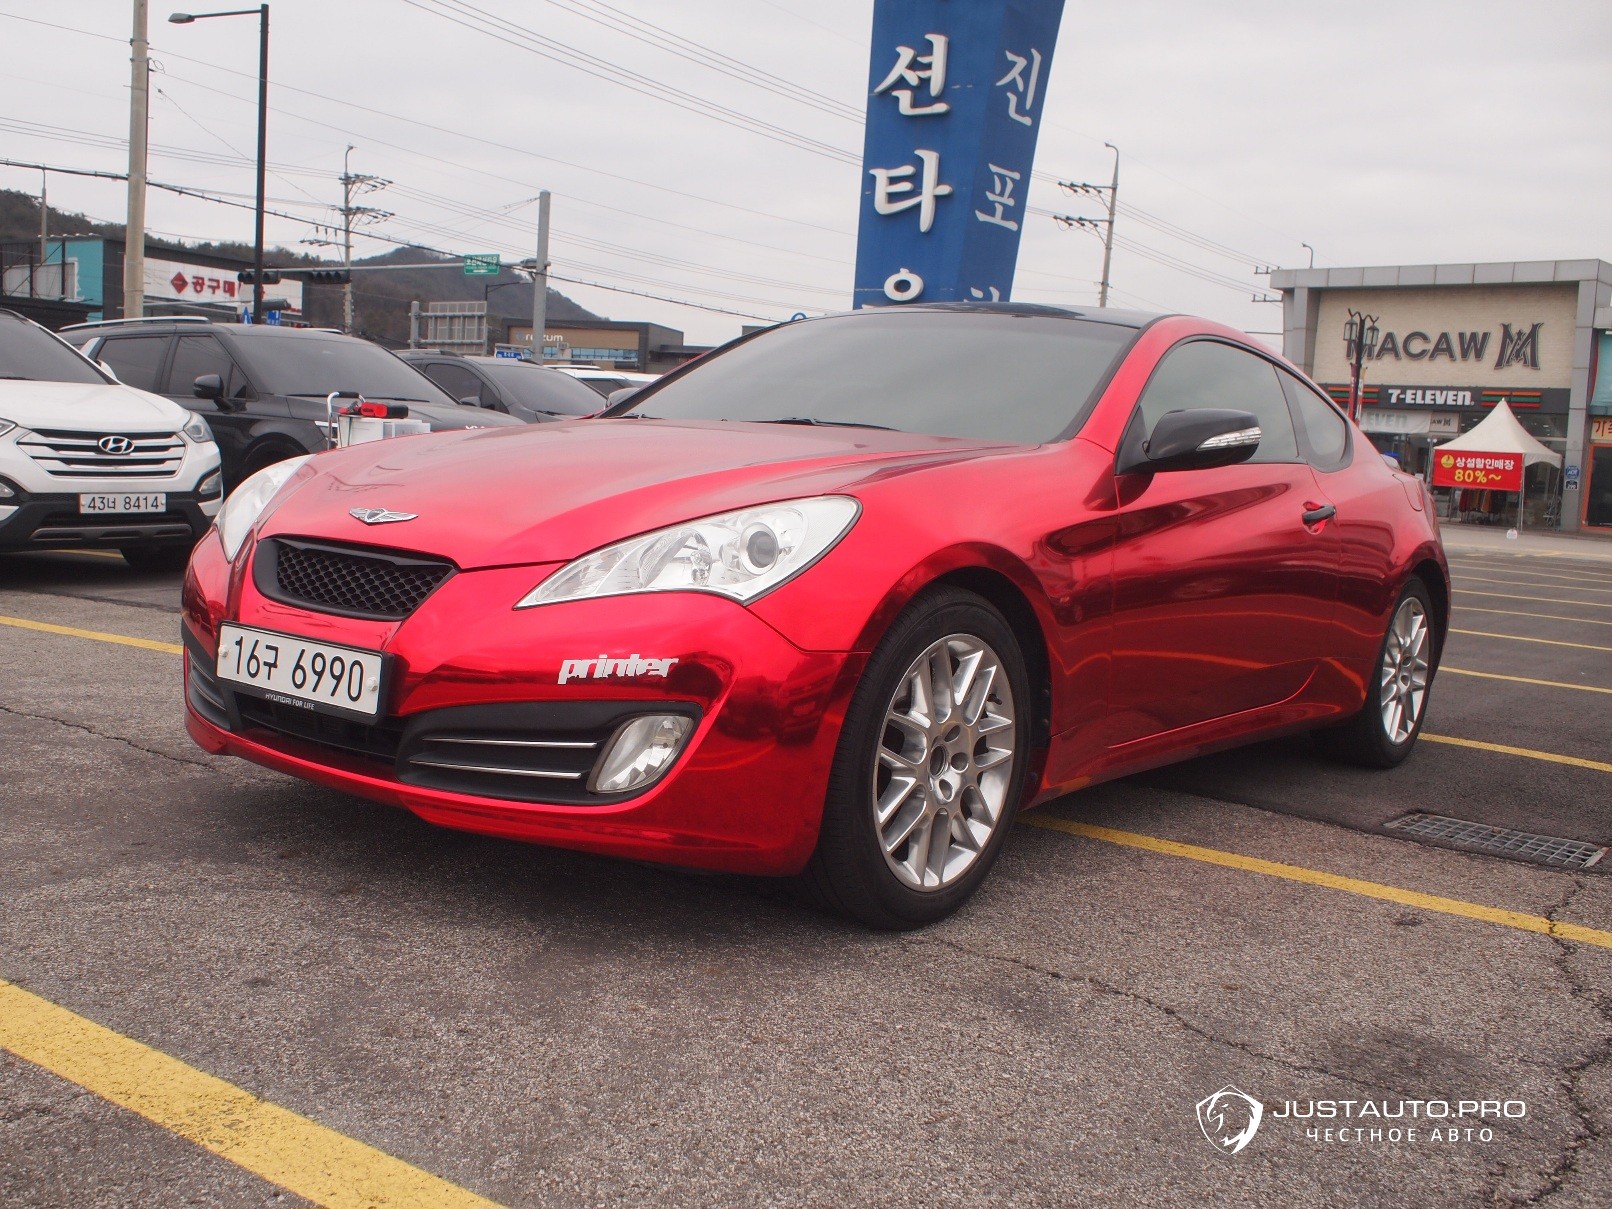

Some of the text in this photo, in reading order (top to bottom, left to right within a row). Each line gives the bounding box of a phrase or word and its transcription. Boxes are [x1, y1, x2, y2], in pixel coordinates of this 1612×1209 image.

[1455, 457, 1515, 470] 상설할인매장
[88, 496, 159, 511] 43너 8414
[235, 635, 364, 702] 16구 6990
[557, 653, 680, 685] printer
[265, 692, 315, 711] HYUNDAI FOR LIFE
